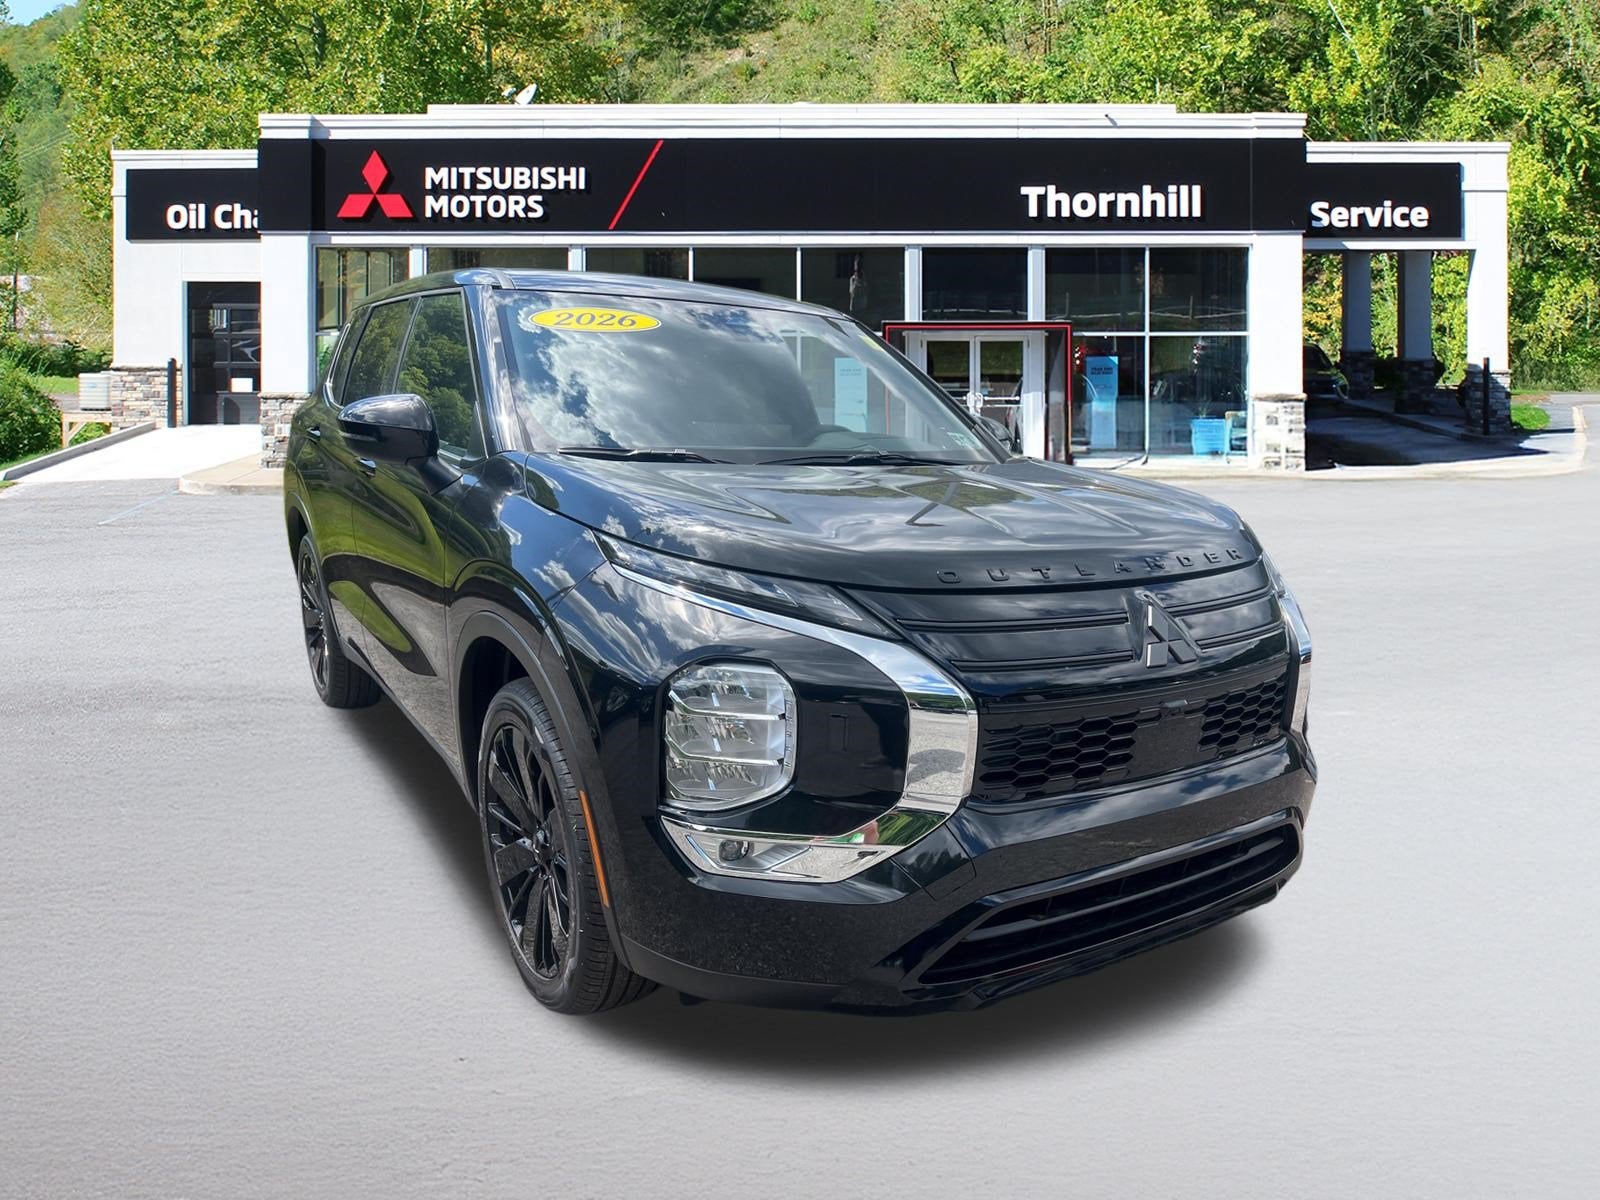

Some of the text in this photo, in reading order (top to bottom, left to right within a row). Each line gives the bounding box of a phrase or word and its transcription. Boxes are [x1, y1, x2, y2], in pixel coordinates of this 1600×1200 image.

[424, 166, 586, 191] MITSUBISHI
[424, 194, 544, 219] MOTORS
[1020, 184, 1202, 219] Thornhill
[1310, 200, 1429, 228] Service
[166, 203, 206, 230] Oil
[553, 312, 637, 327] 2026
[936, 549, 1244, 584] OUTLANDER
